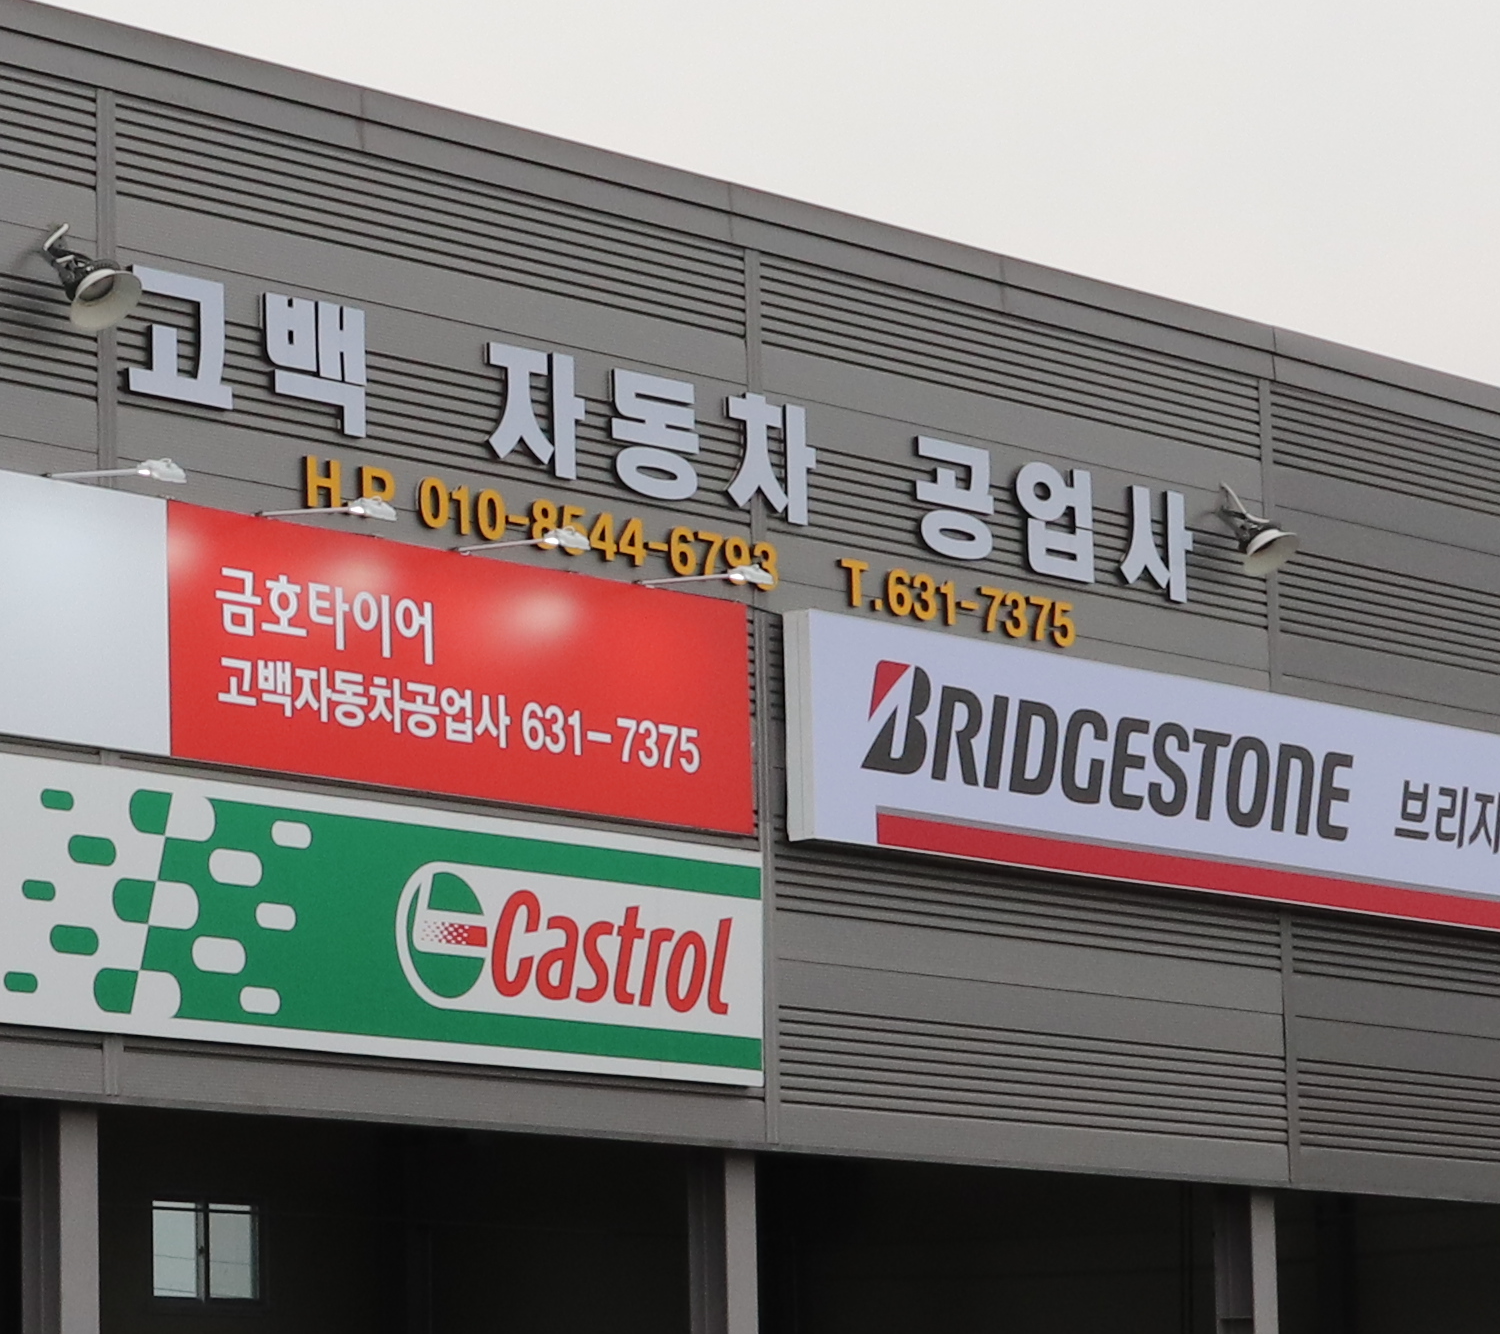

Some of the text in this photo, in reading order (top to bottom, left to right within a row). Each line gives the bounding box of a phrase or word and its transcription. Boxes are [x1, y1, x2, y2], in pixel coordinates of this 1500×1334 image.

[126, 264, 1193, 604] 고백 자동차 공업사
[214, 566, 435, 665] 금호타이어
[216, 657, 702, 775] 고백자동차공업사 631-7375
[861, 659, 1354, 842] BRIDGESTONE
[491, 889, 734, 1016] Castrol
